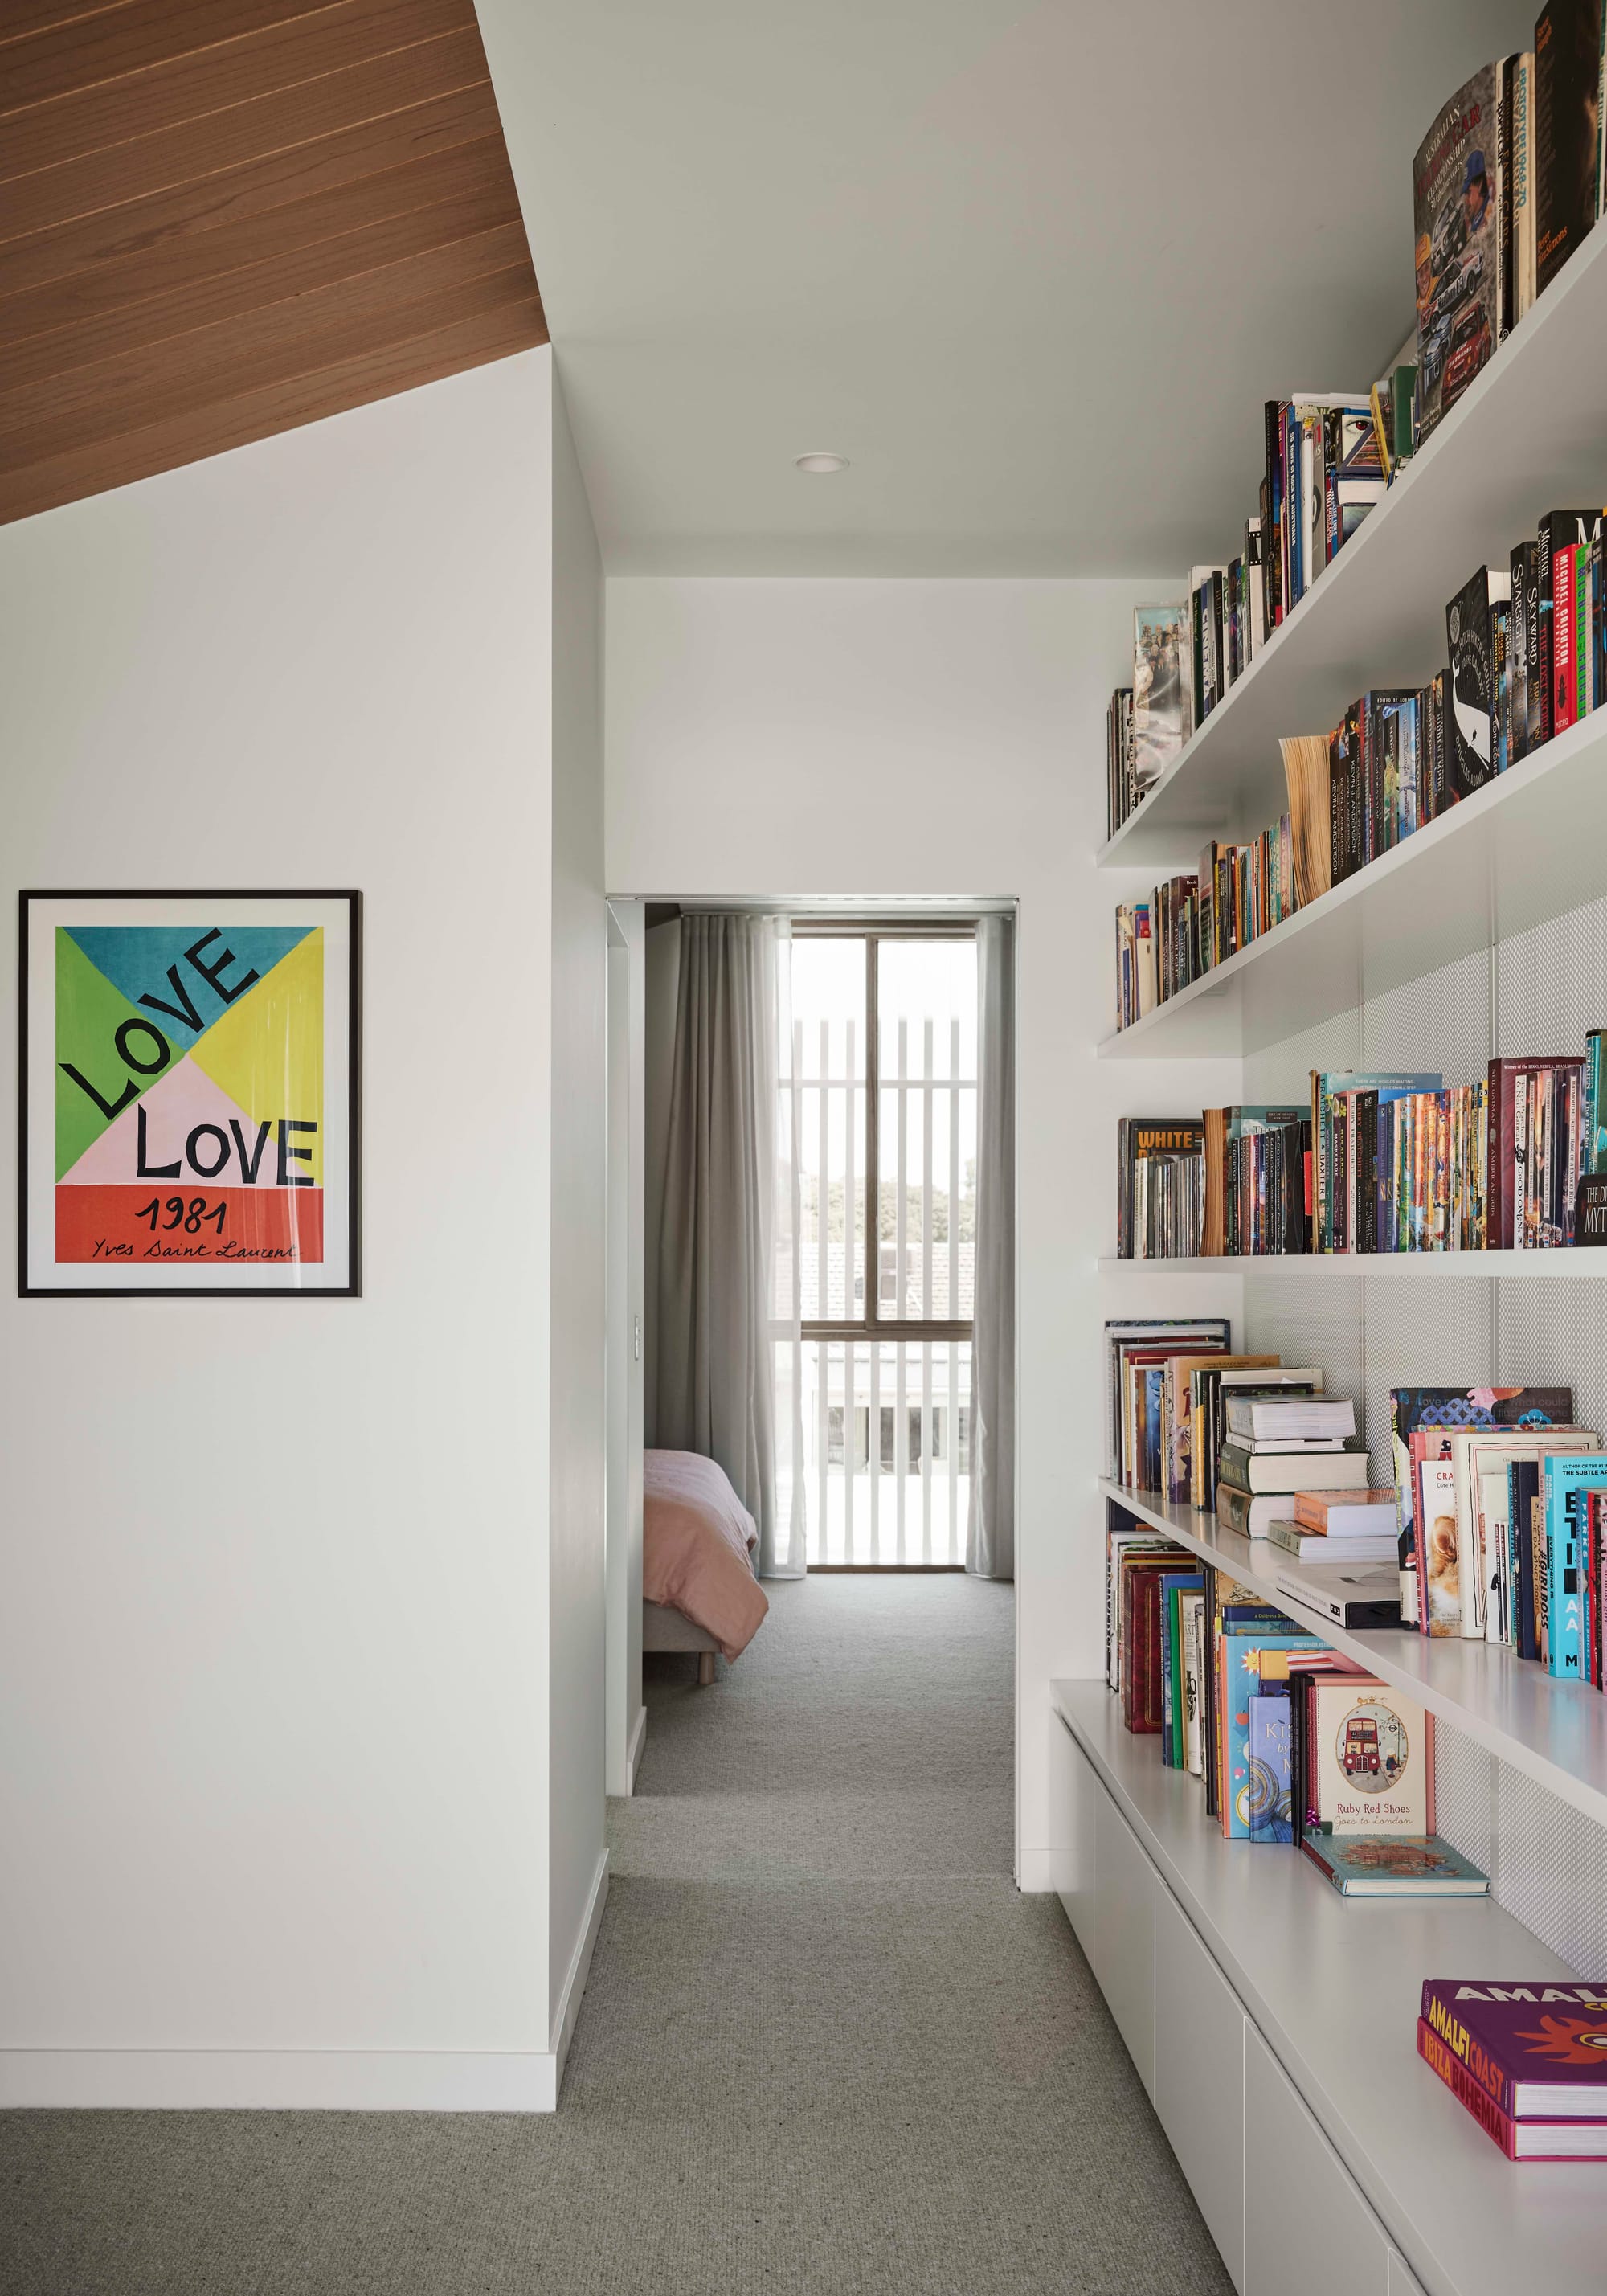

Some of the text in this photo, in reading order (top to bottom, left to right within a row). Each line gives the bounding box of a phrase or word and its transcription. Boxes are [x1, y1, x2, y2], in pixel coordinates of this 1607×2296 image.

[1519, 68, 1527, 151] PROTOTYPE
[1540, 527, 1551, 580] MICHAEL
[1512, 564, 1523, 655] STARSIGHT
[1527, 587, 1538, 665] SKYWARD
[1560, 553, 1568, 666] MICHAEL CRICHTON
[1540, 624, 1548, 741] THE LOST WORLD
[1455, 735, 1485, 788] DOUGLAS ADAMS
[58, 927, 260, 1120] LOVE
[137, 1103, 318, 1186] LOVE
[1138, 1132, 1192, 1148] WHITE
[135, 1196, 227, 1234] 1981
[1586, 1186, 1599, 1203] THE
[92, 1239, 302, 1259] Yves Saint Laurent
[1539, 1549, 1548, 1629] #GIRLBOSS
[1293, 1641, 1319, 1649] PROFESSOR
[1278, 1742, 1289, 1754] by
[1334, 1816, 1413, 1831] Goes to London
[1337, 1803, 1411, 1816] Ruby Red Shoes
[1425, 2030, 1452, 2086] IBIZA
[1429, 1995, 1470, 2065] AMALFI
[1469, 2041, 1504, 2102] COAST
[1453, 2061, 1503, 2144] BOHEMIA
